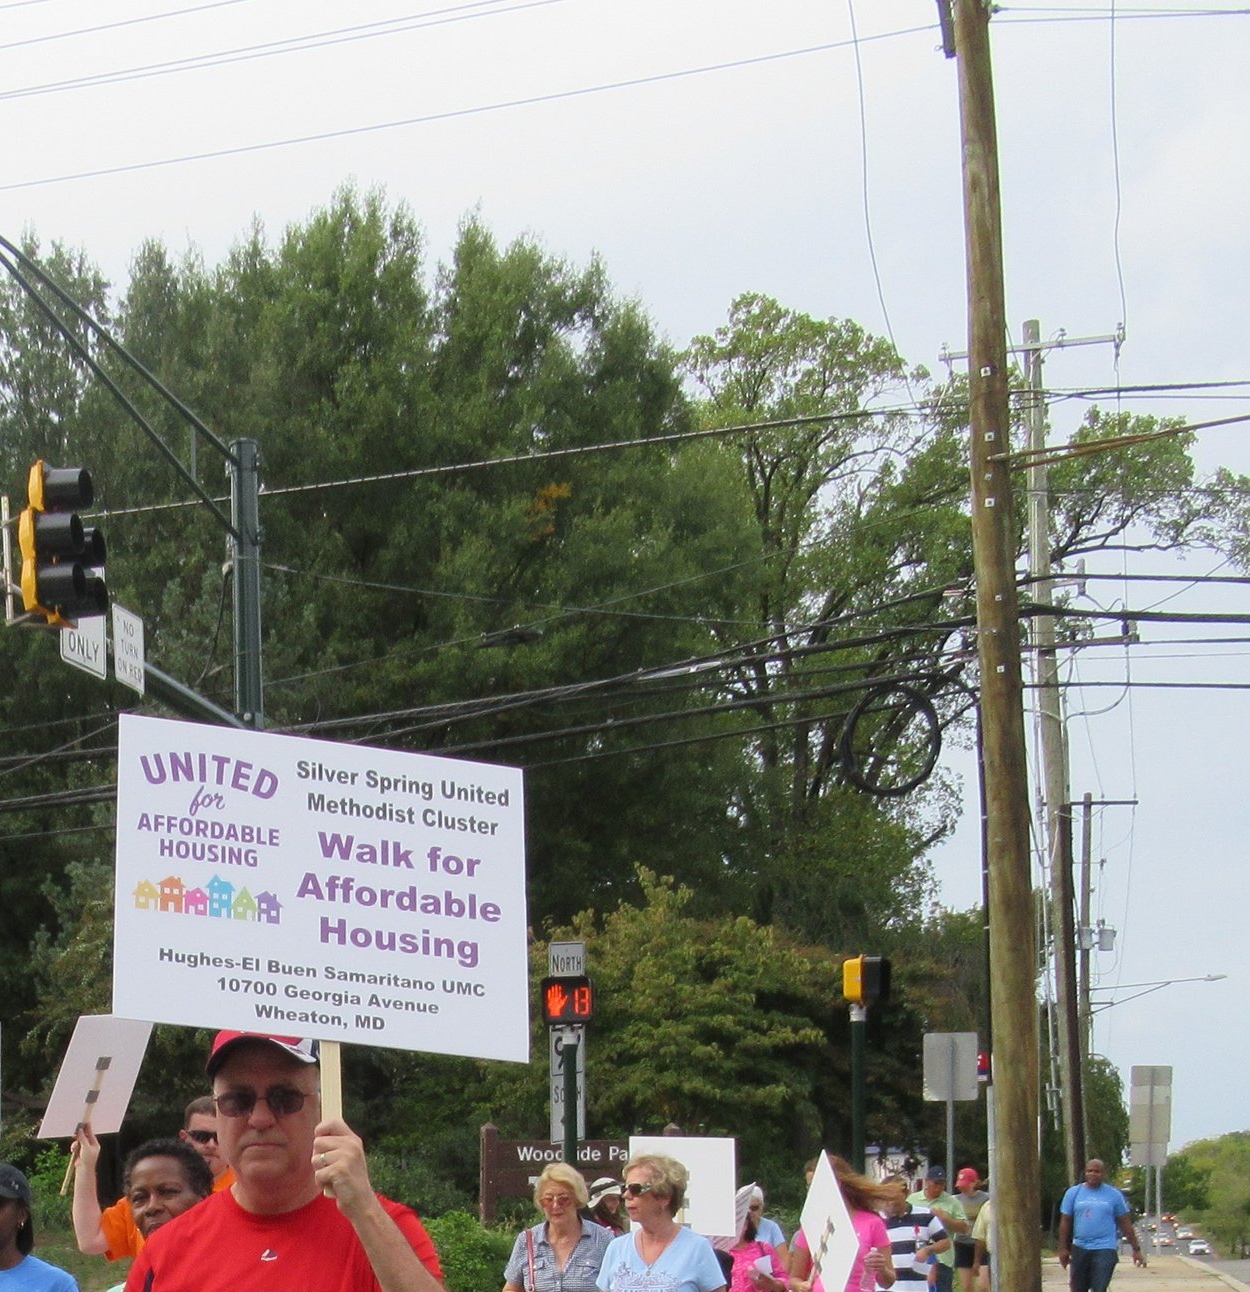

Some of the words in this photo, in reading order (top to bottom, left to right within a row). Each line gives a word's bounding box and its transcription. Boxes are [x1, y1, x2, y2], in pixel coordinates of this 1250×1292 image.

[123, 620, 135, 637] NO
[69, 631, 99, 663] ONLY
[121, 639, 139, 659] TURN
[118, 658, 128, 675] ON
[129, 663, 142, 682] RED
[140, 752, 278, 799] UNITED
[297, 761, 358, 785] Silver
[366, 770, 432, 800] Spring
[442, 780, 509, 806] United
[190, 786, 225, 816] for
[308, 793, 414, 824] Methodist
[423, 809, 498, 835] Cluster
[138, 813, 279, 846] AFFORDABLE
[160, 839, 257, 867] HOUSING
[318, 832, 414, 868] Walk
[427, 847, 481, 877] for
[297, 873, 501, 922] Affordable
[321, 917, 478, 968] Housing
[160, 948, 259, 971] Hughes-El
[268, 960, 316, 977] Buen
[325, 967, 434, 990] Samaritano
[443, 980, 484, 996] UMC
[552, 954, 582, 973] NORTH
[218, 978, 277, 996] 10700
[285, 985, 360, 1006] Georgia
[368, 994, 438, 1013] Avenue
[574, 987, 591, 1015] 13
[255, 1004, 347, 1029] Wheaton,
[356, 1015, 384, 1029] MD
